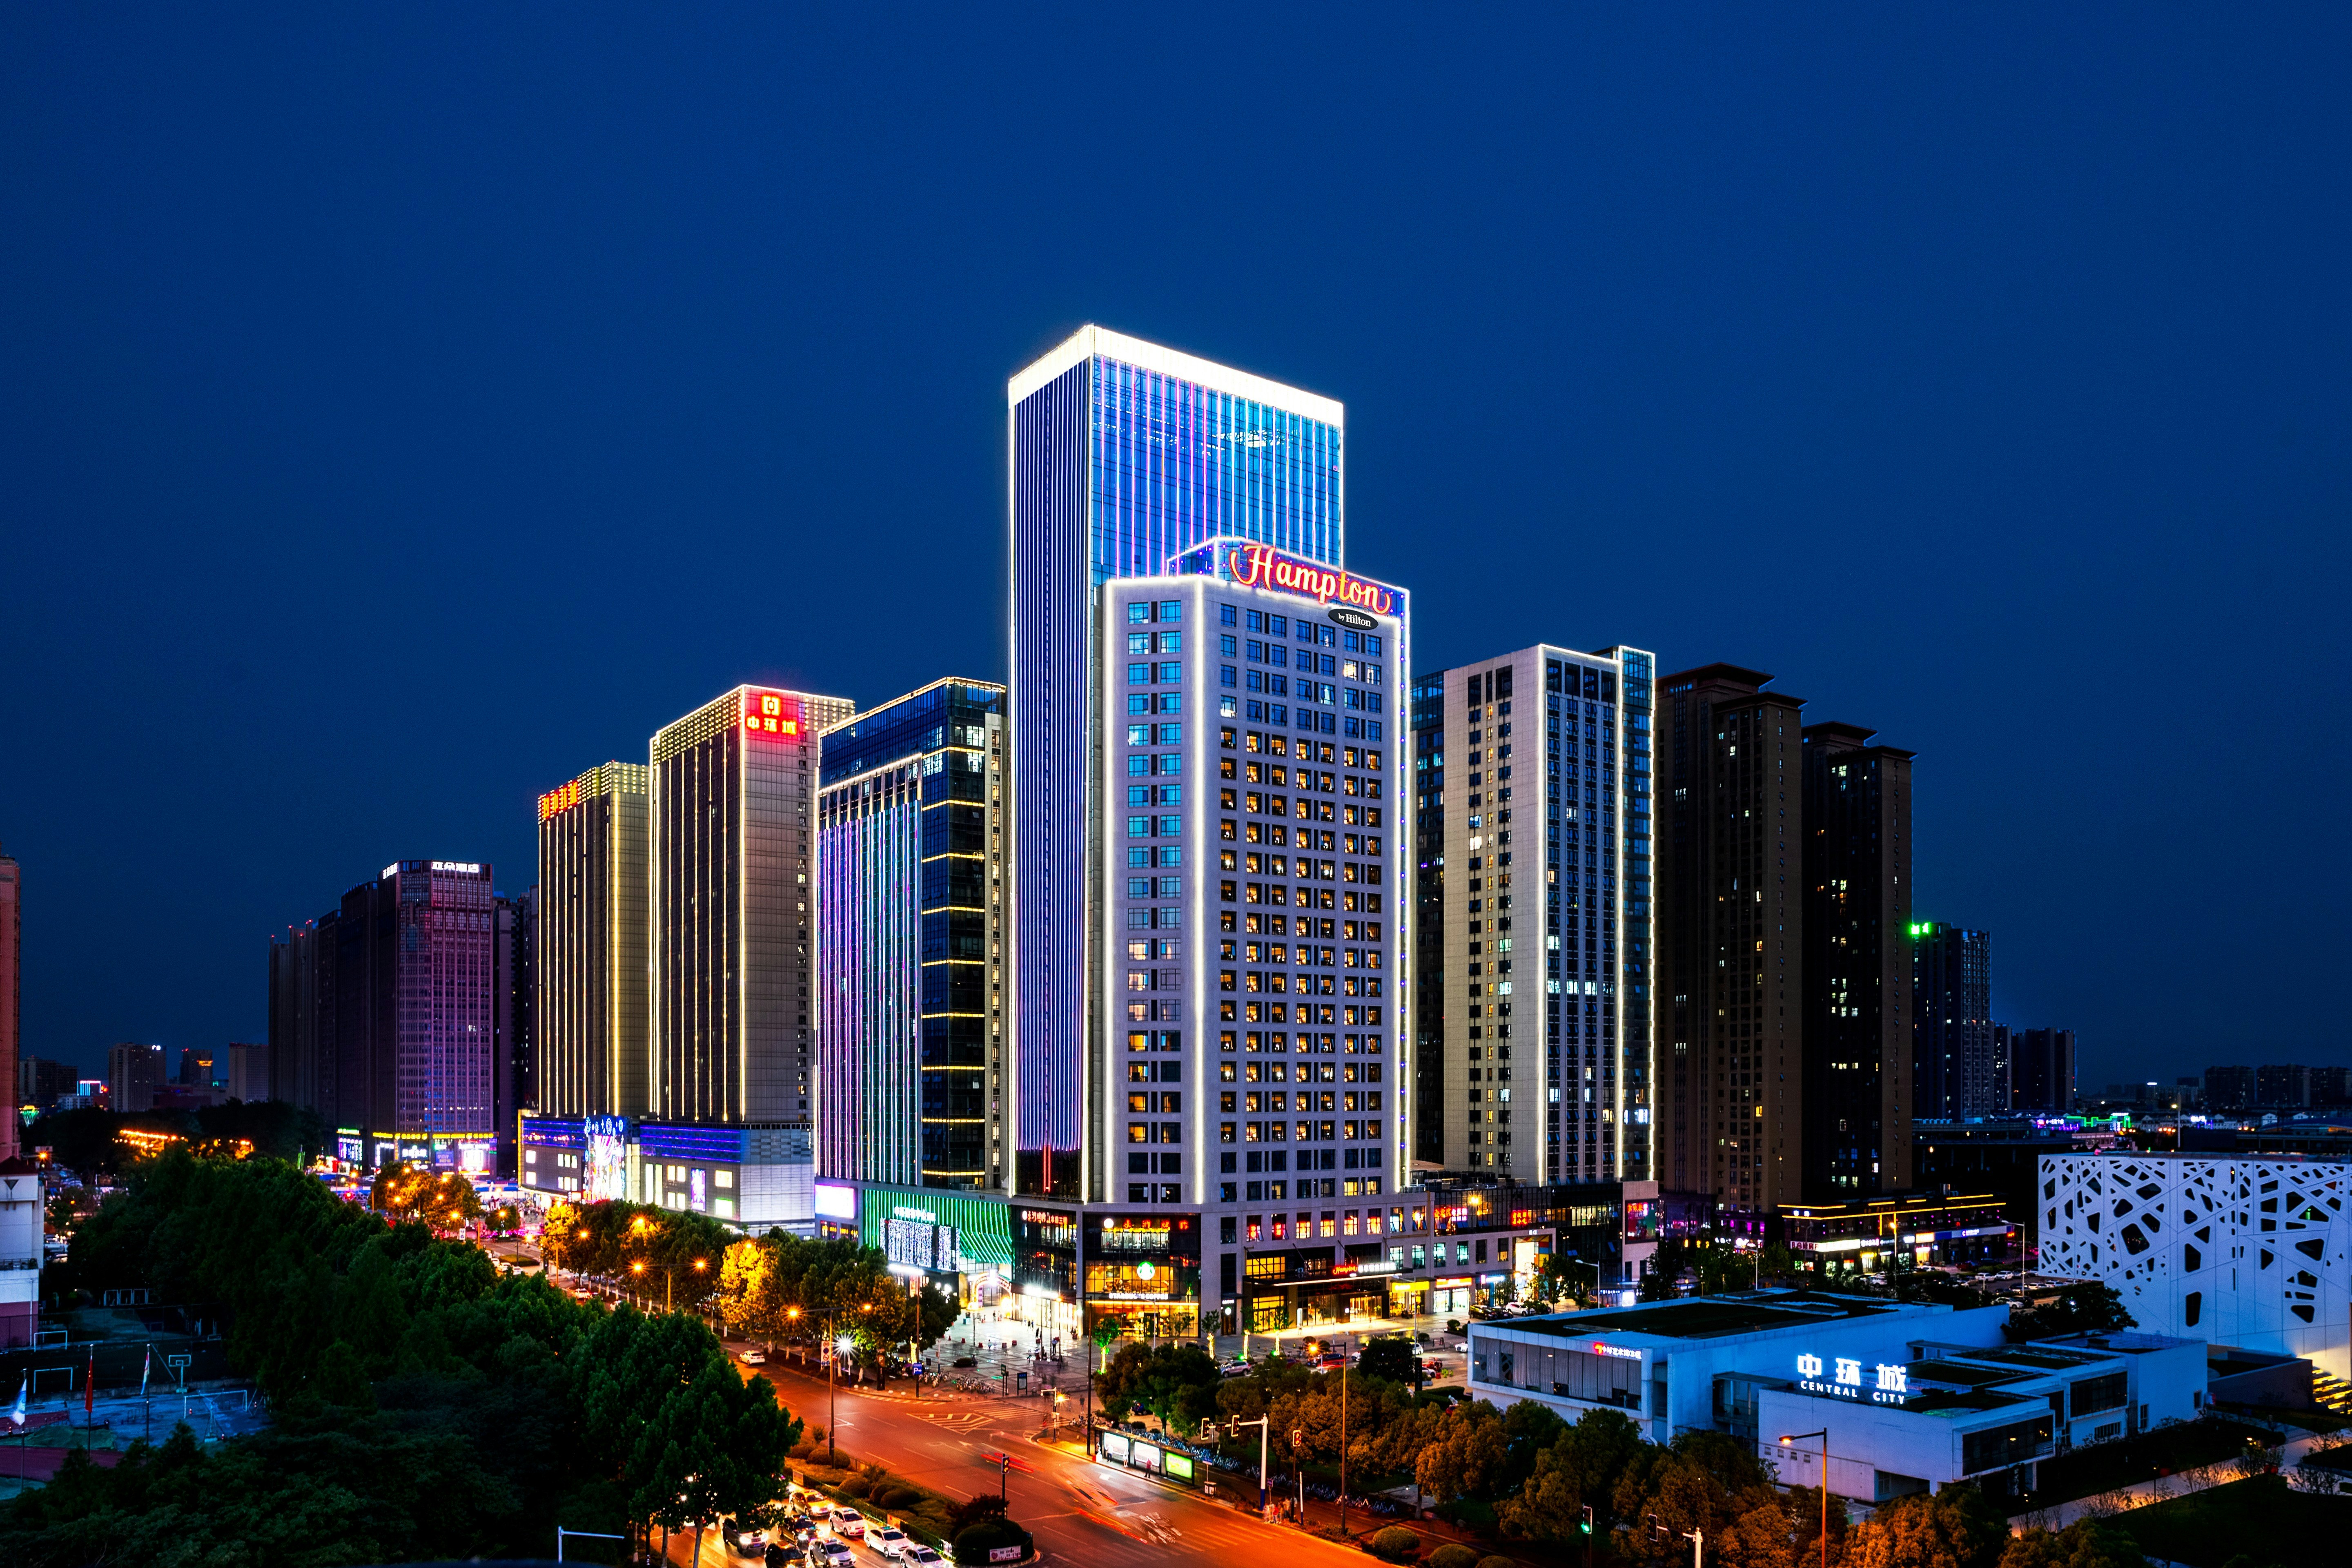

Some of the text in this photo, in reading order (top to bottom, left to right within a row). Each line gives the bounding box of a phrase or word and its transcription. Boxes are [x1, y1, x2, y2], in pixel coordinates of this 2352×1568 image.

[1230, 545, 1391, 614] Hampton
[1345, 614, 1371, 627] Hilton
[746, 716, 797, 735] 中环城
[432, 861, 479, 873] 亚朵酒店
[1333, 1265, 1358, 1275] Hampton
[1797, 1354, 1907, 1392] 中环城
[1800, 1381, 1904, 1404] CENTRAL CITY
